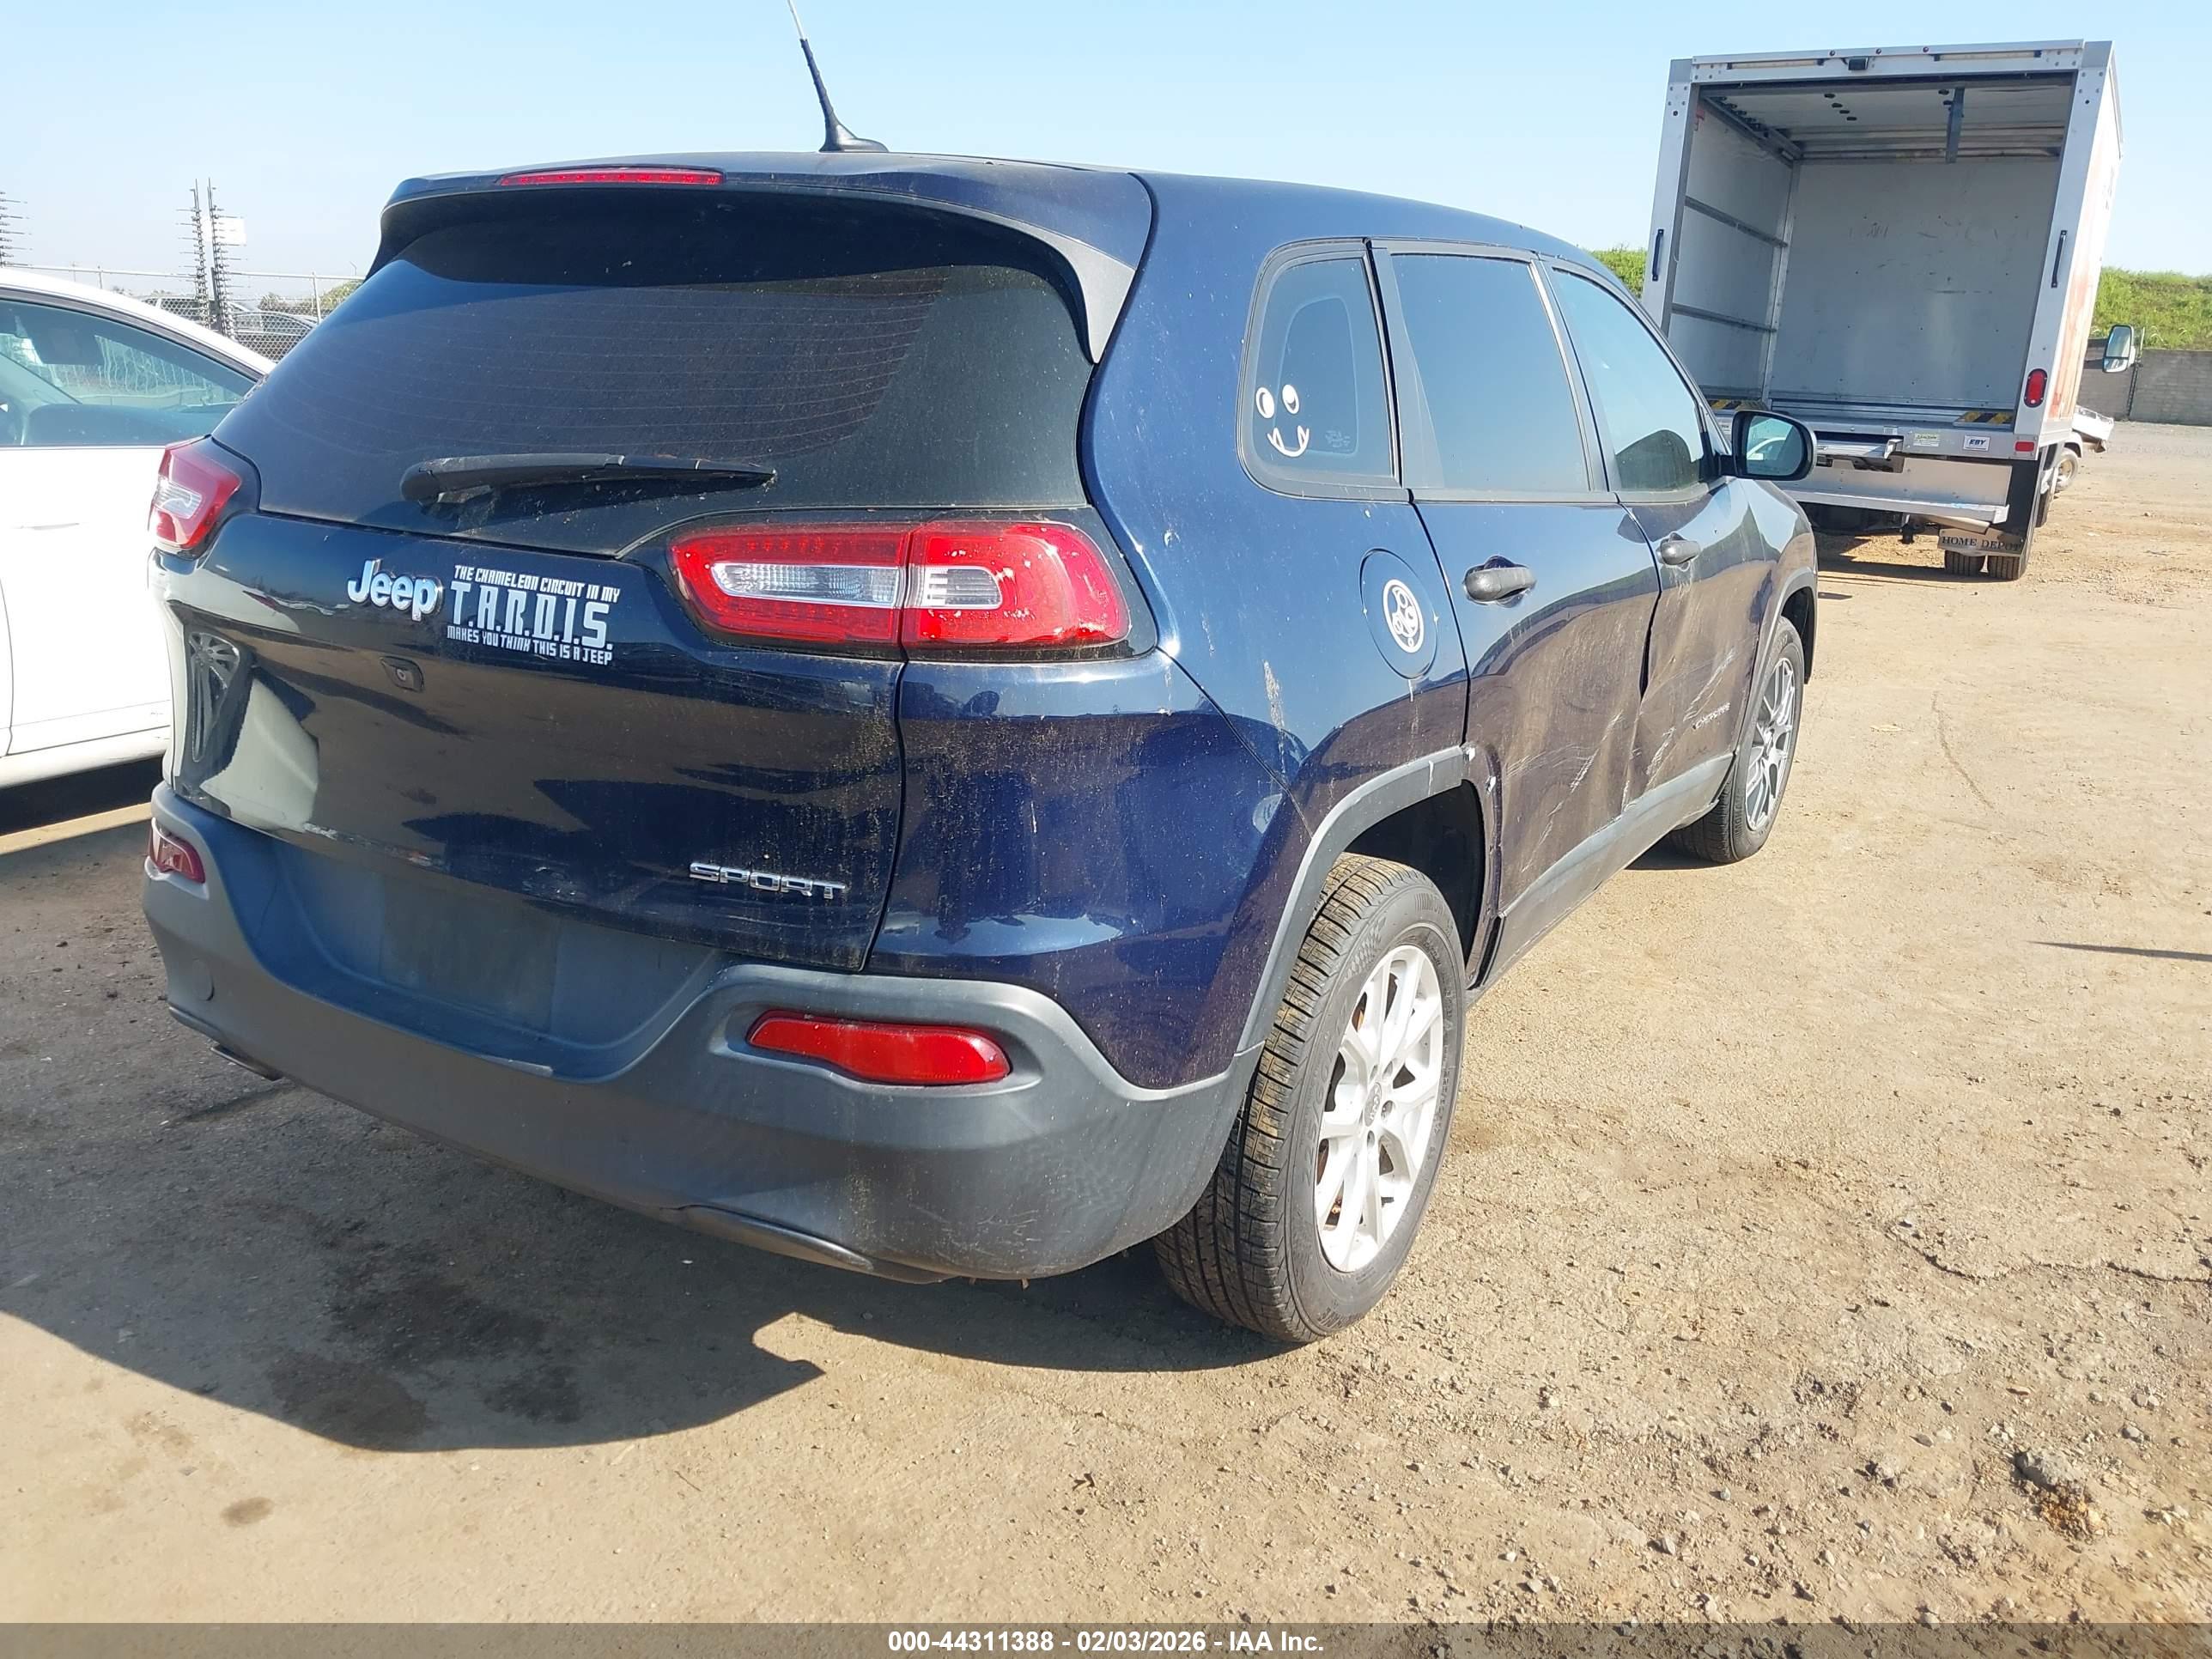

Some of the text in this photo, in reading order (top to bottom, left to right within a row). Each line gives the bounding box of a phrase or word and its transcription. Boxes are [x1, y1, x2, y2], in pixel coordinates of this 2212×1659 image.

[1942, 536, 1977, 547] HOME
[347, 559, 443, 623] Jeep
[454, 564, 621, 603] THE CHAMELEON CIRCUIT IN MY
[450, 580, 614, 650] T.A.R.D.I.S.
[447, 625, 613, 665] MAKES YOU THINK THIS IS A JEEP
[689, 862, 846, 900] SPORT
